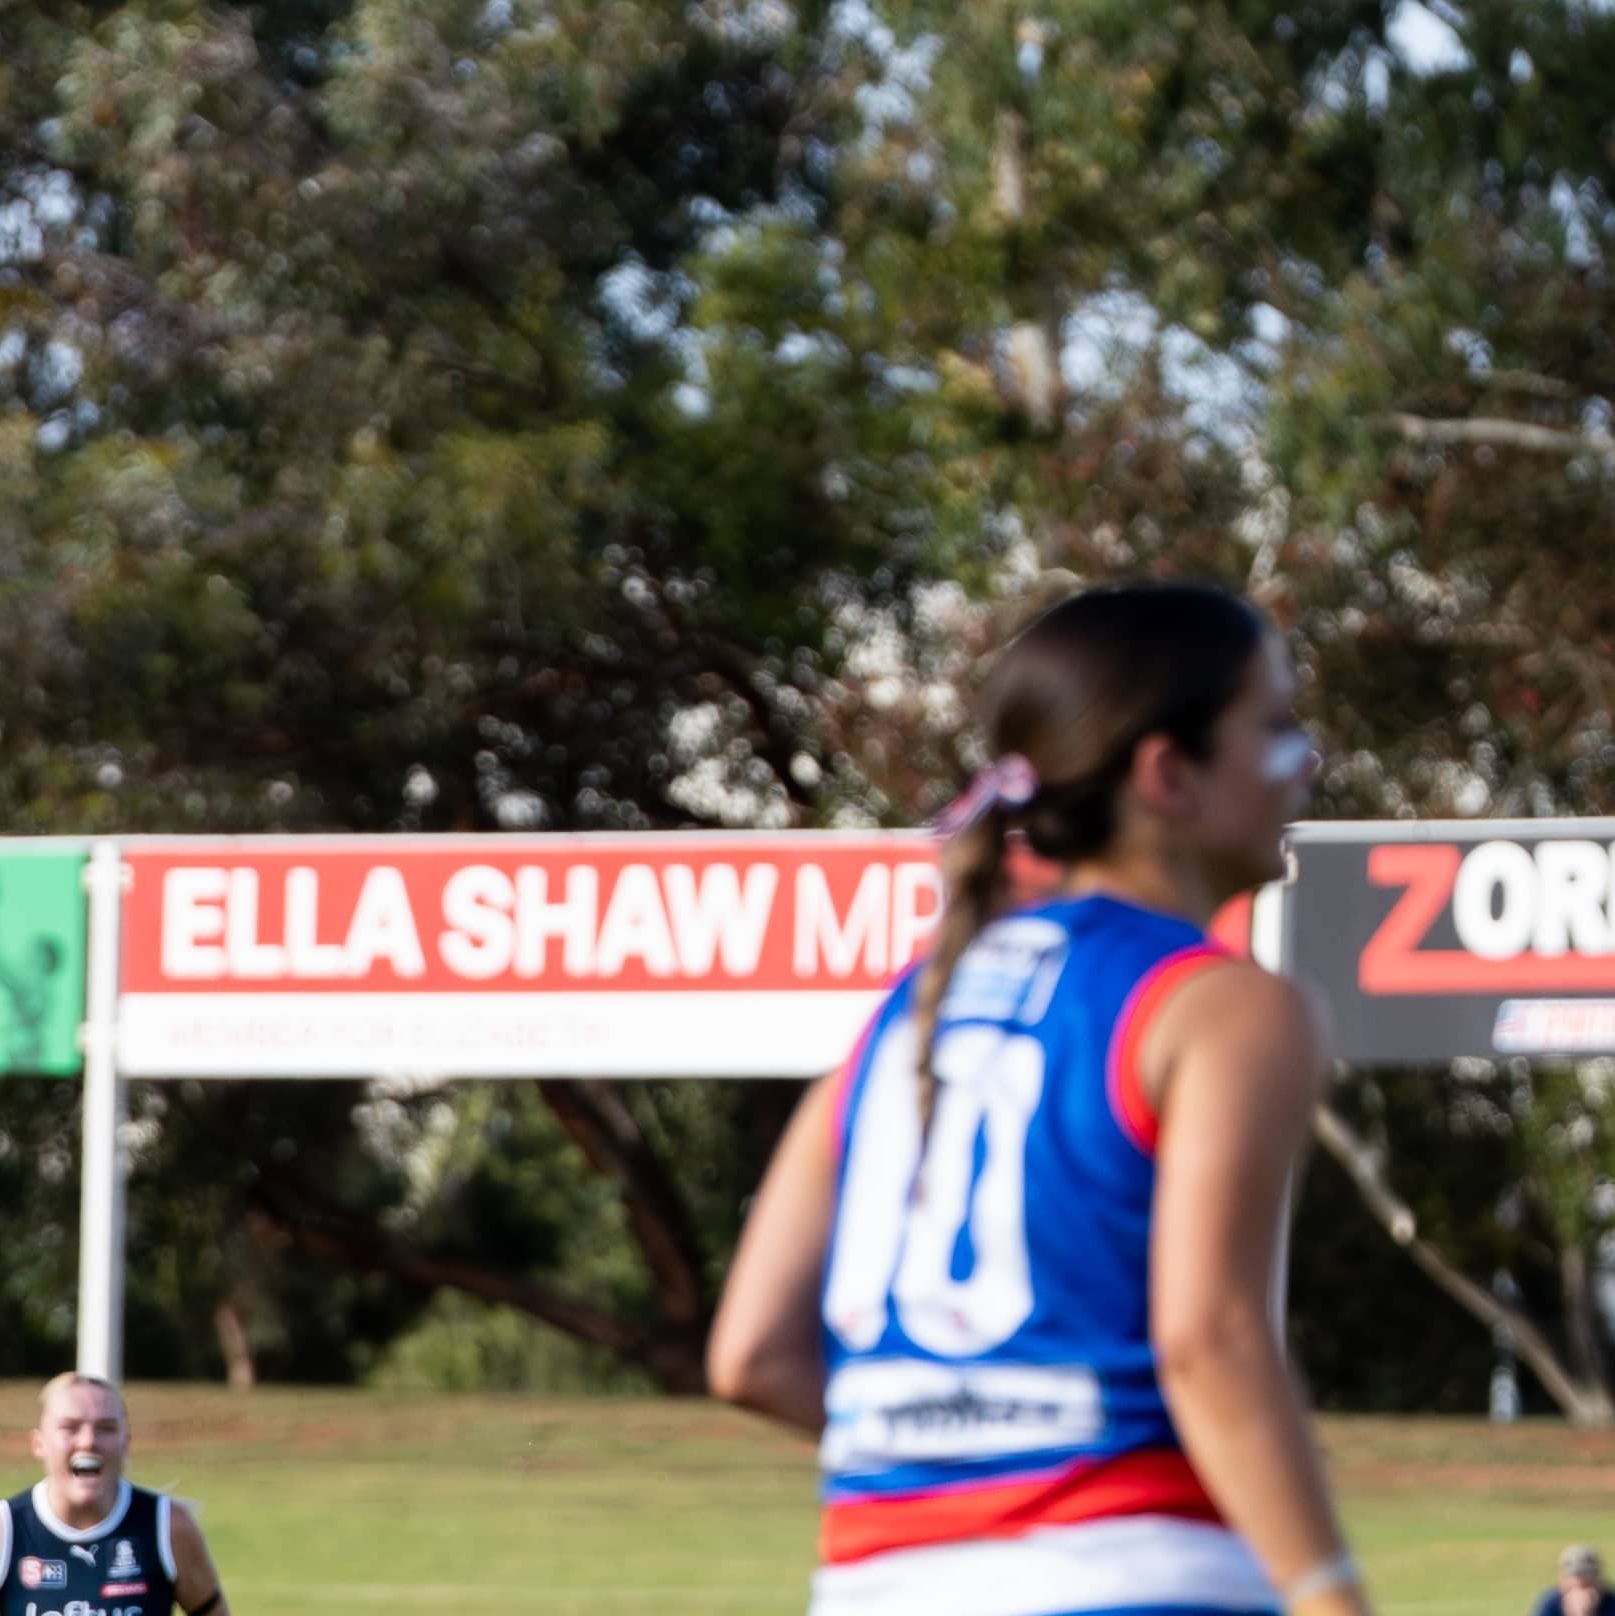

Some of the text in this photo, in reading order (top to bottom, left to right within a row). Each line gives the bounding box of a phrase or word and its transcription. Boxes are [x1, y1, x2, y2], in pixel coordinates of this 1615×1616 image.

[161, 866, 427, 980] ELLA
[438, 862, 779, 980] SHAW
[793, 862, 949, 979] MP
[1358, 840, 1615, 994] ZOR
